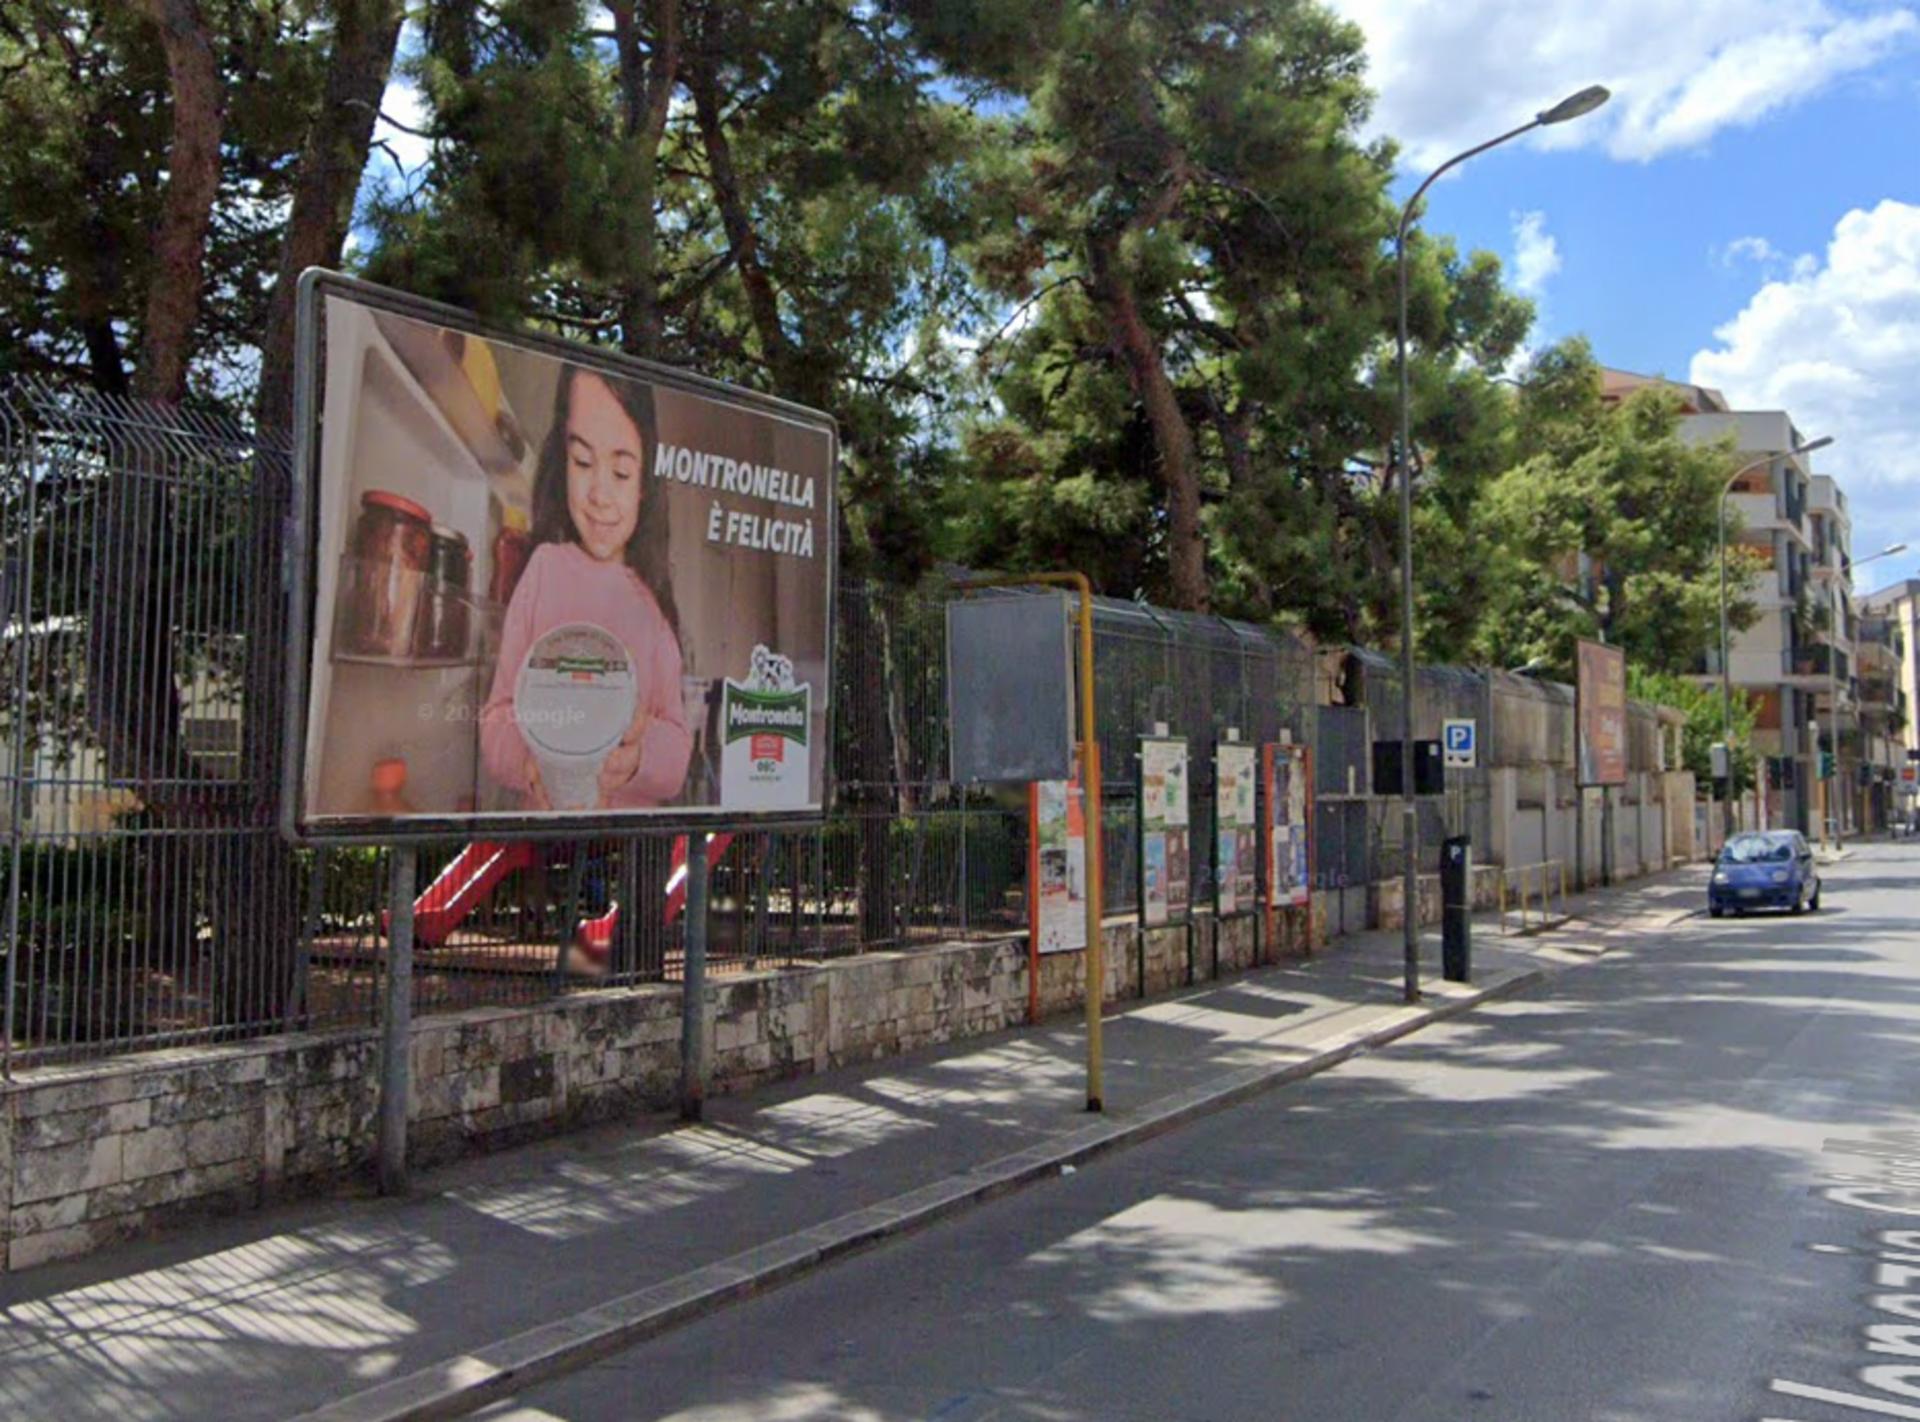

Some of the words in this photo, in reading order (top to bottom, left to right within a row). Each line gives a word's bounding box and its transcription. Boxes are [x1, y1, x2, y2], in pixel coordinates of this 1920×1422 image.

[654, 443, 815, 509] MONTRONELLA
[707, 501, 722, 541] È
[725, 512, 813, 558] FELICITÀ
[730, 702, 804, 727] Montronella
[1452, 728, 1468, 748] P
